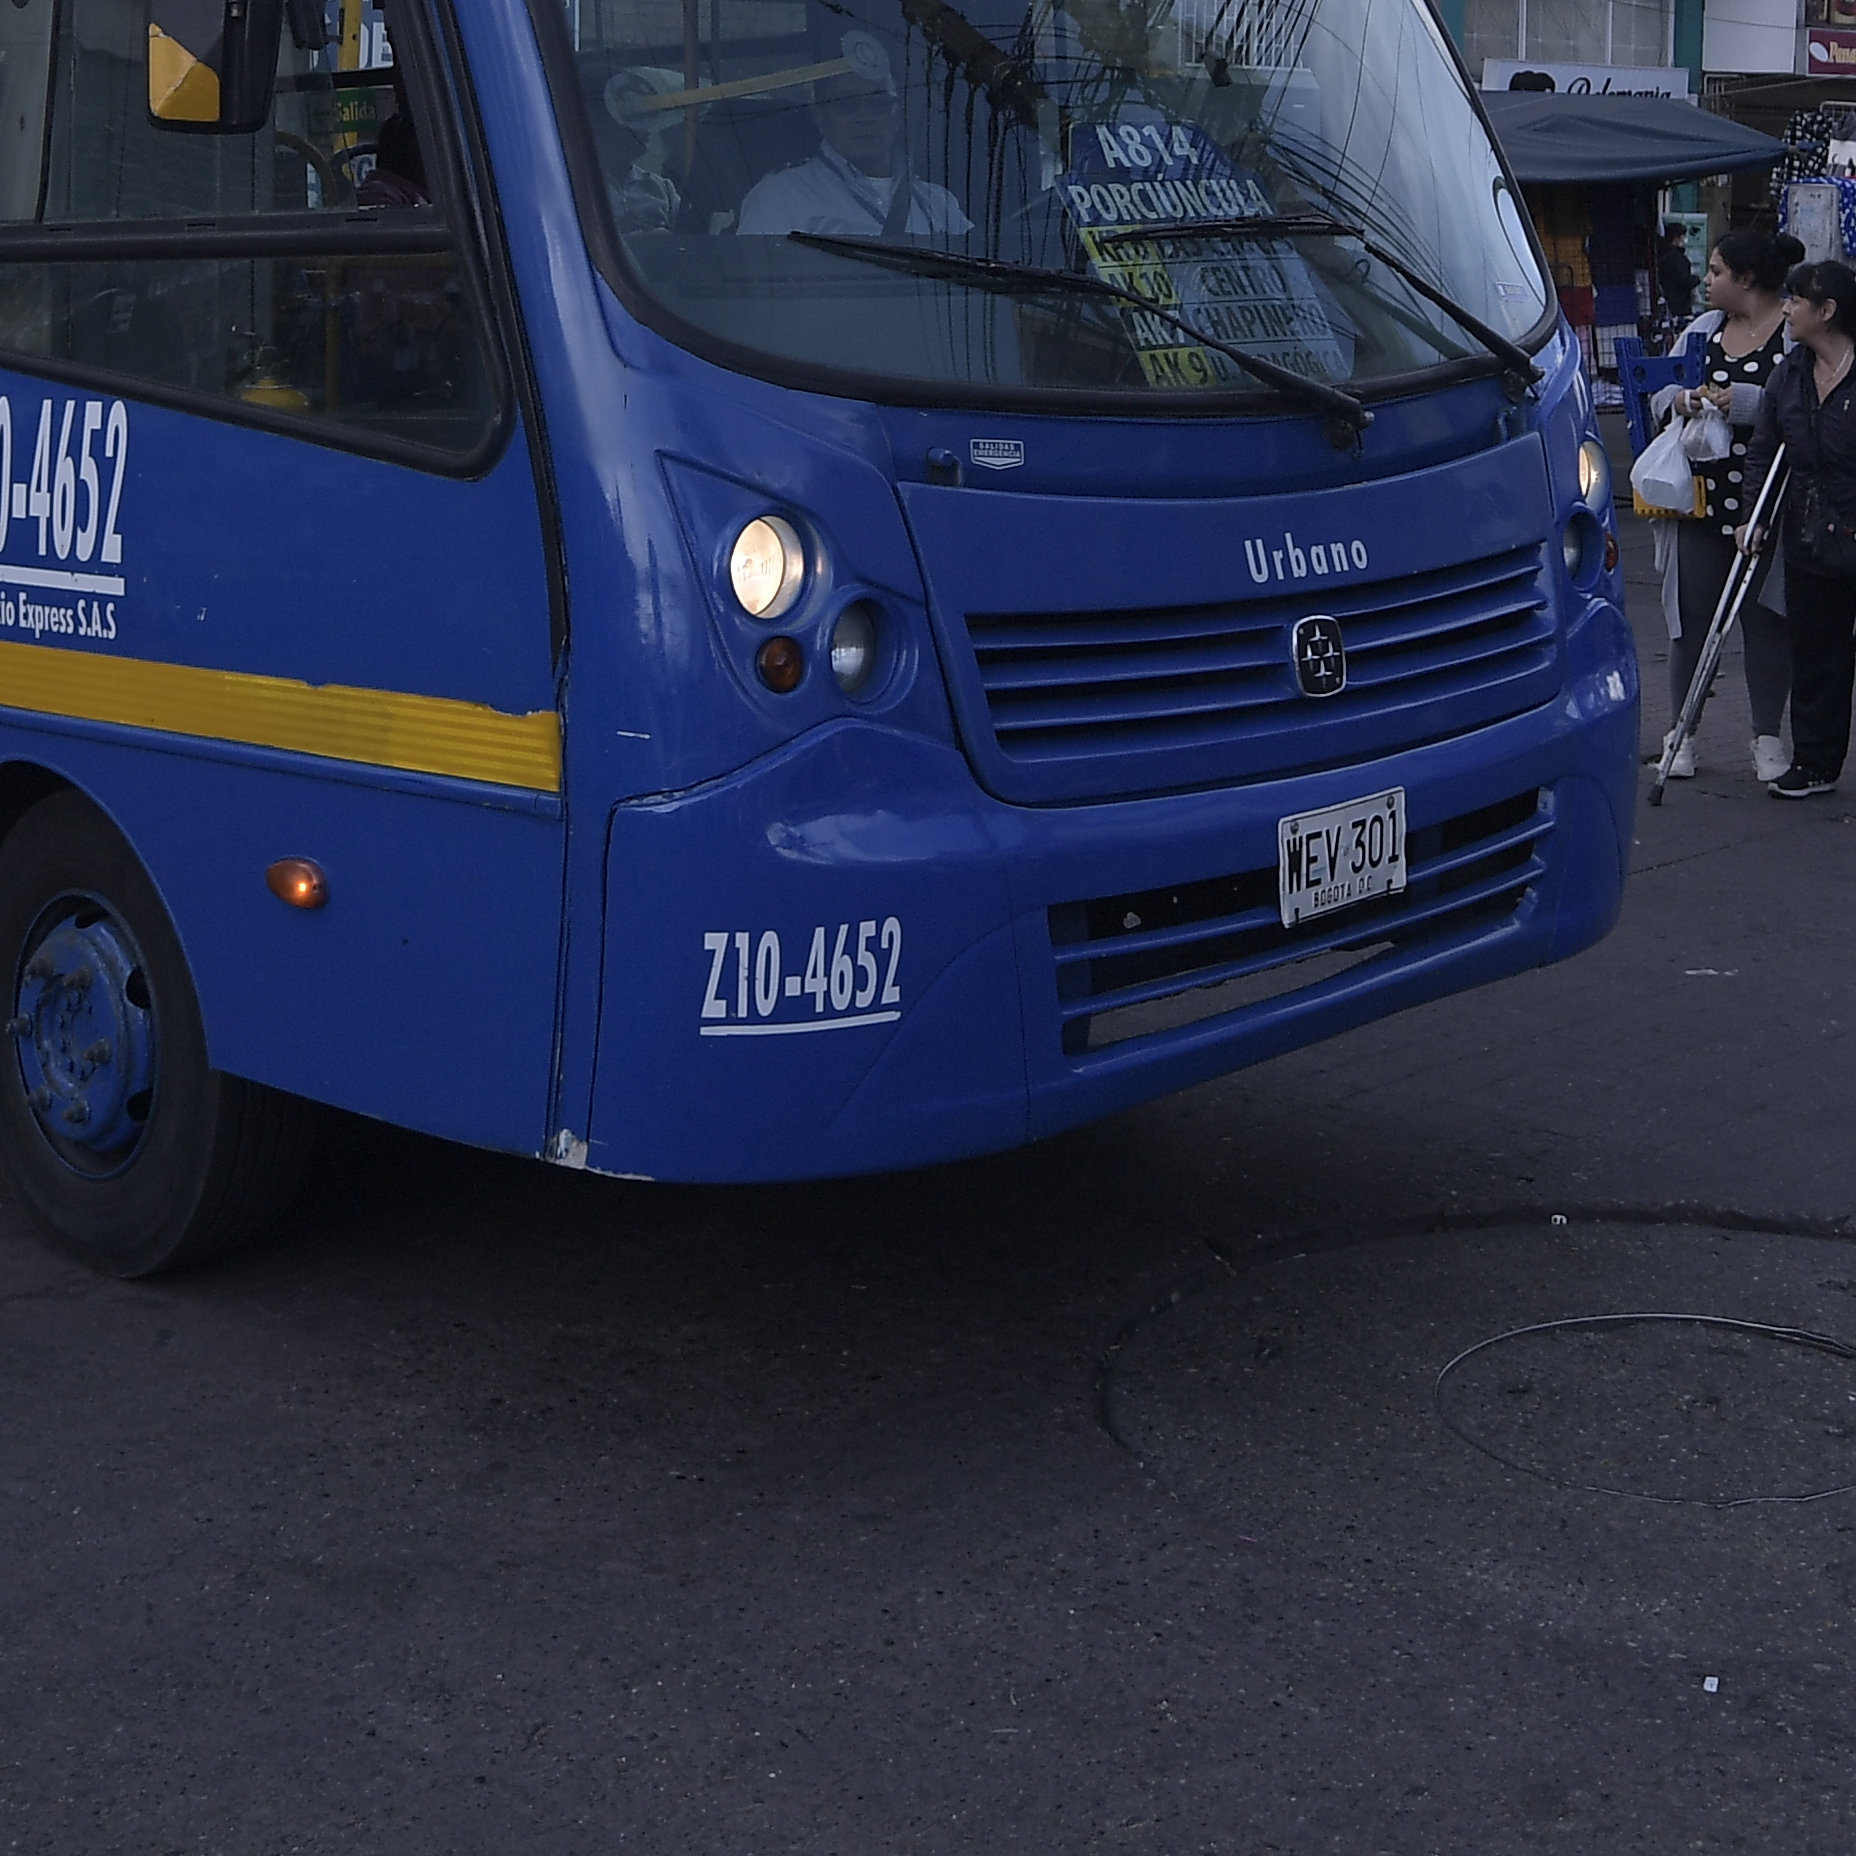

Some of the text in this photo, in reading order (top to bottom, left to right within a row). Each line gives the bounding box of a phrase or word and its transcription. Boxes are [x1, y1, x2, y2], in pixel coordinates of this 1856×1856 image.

[1096, 123, 1200, 170] A814
[1068, 172, 1275, 223] PORCIÚNCULA
[1243, 531, 1368, 584] Urbano
[18, 591, 74, 639] Express
[1285, 809, 1399, 895] WEV 301
[700, 915, 903, 1020] Z10-4652
